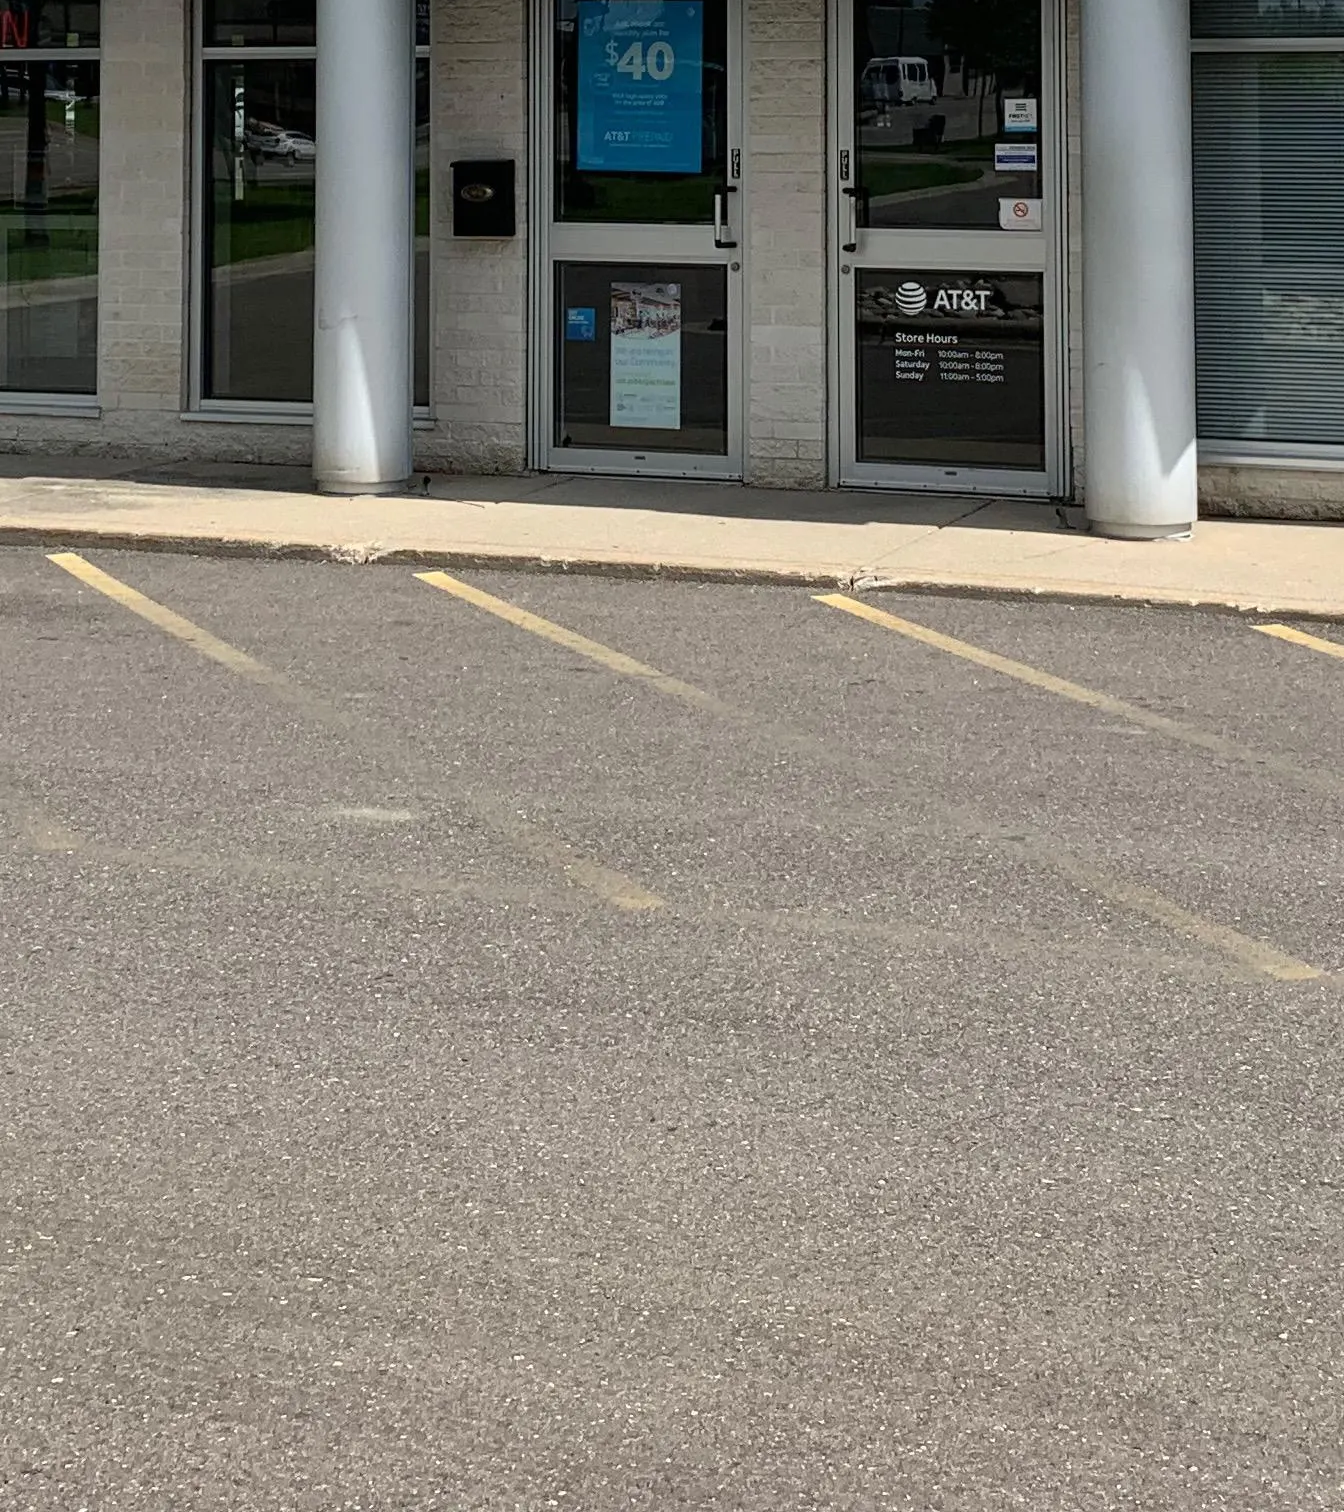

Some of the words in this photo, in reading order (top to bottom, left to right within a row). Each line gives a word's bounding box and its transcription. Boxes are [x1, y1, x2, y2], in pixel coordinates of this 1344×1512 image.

[605, 39, 675, 81] $40
[604, 131, 631, 141] AT&T
[934, 290, 990, 310] AT&T
[896, 333, 924, 343] Store
[926, 333, 958, 344] Hours
[896, 349, 925, 357] Mon-Fri
[938, 350, 969, 359] 10:00am
[896, 360, 930, 370] Saturday
[896, 371, 924, 381] Sunday
